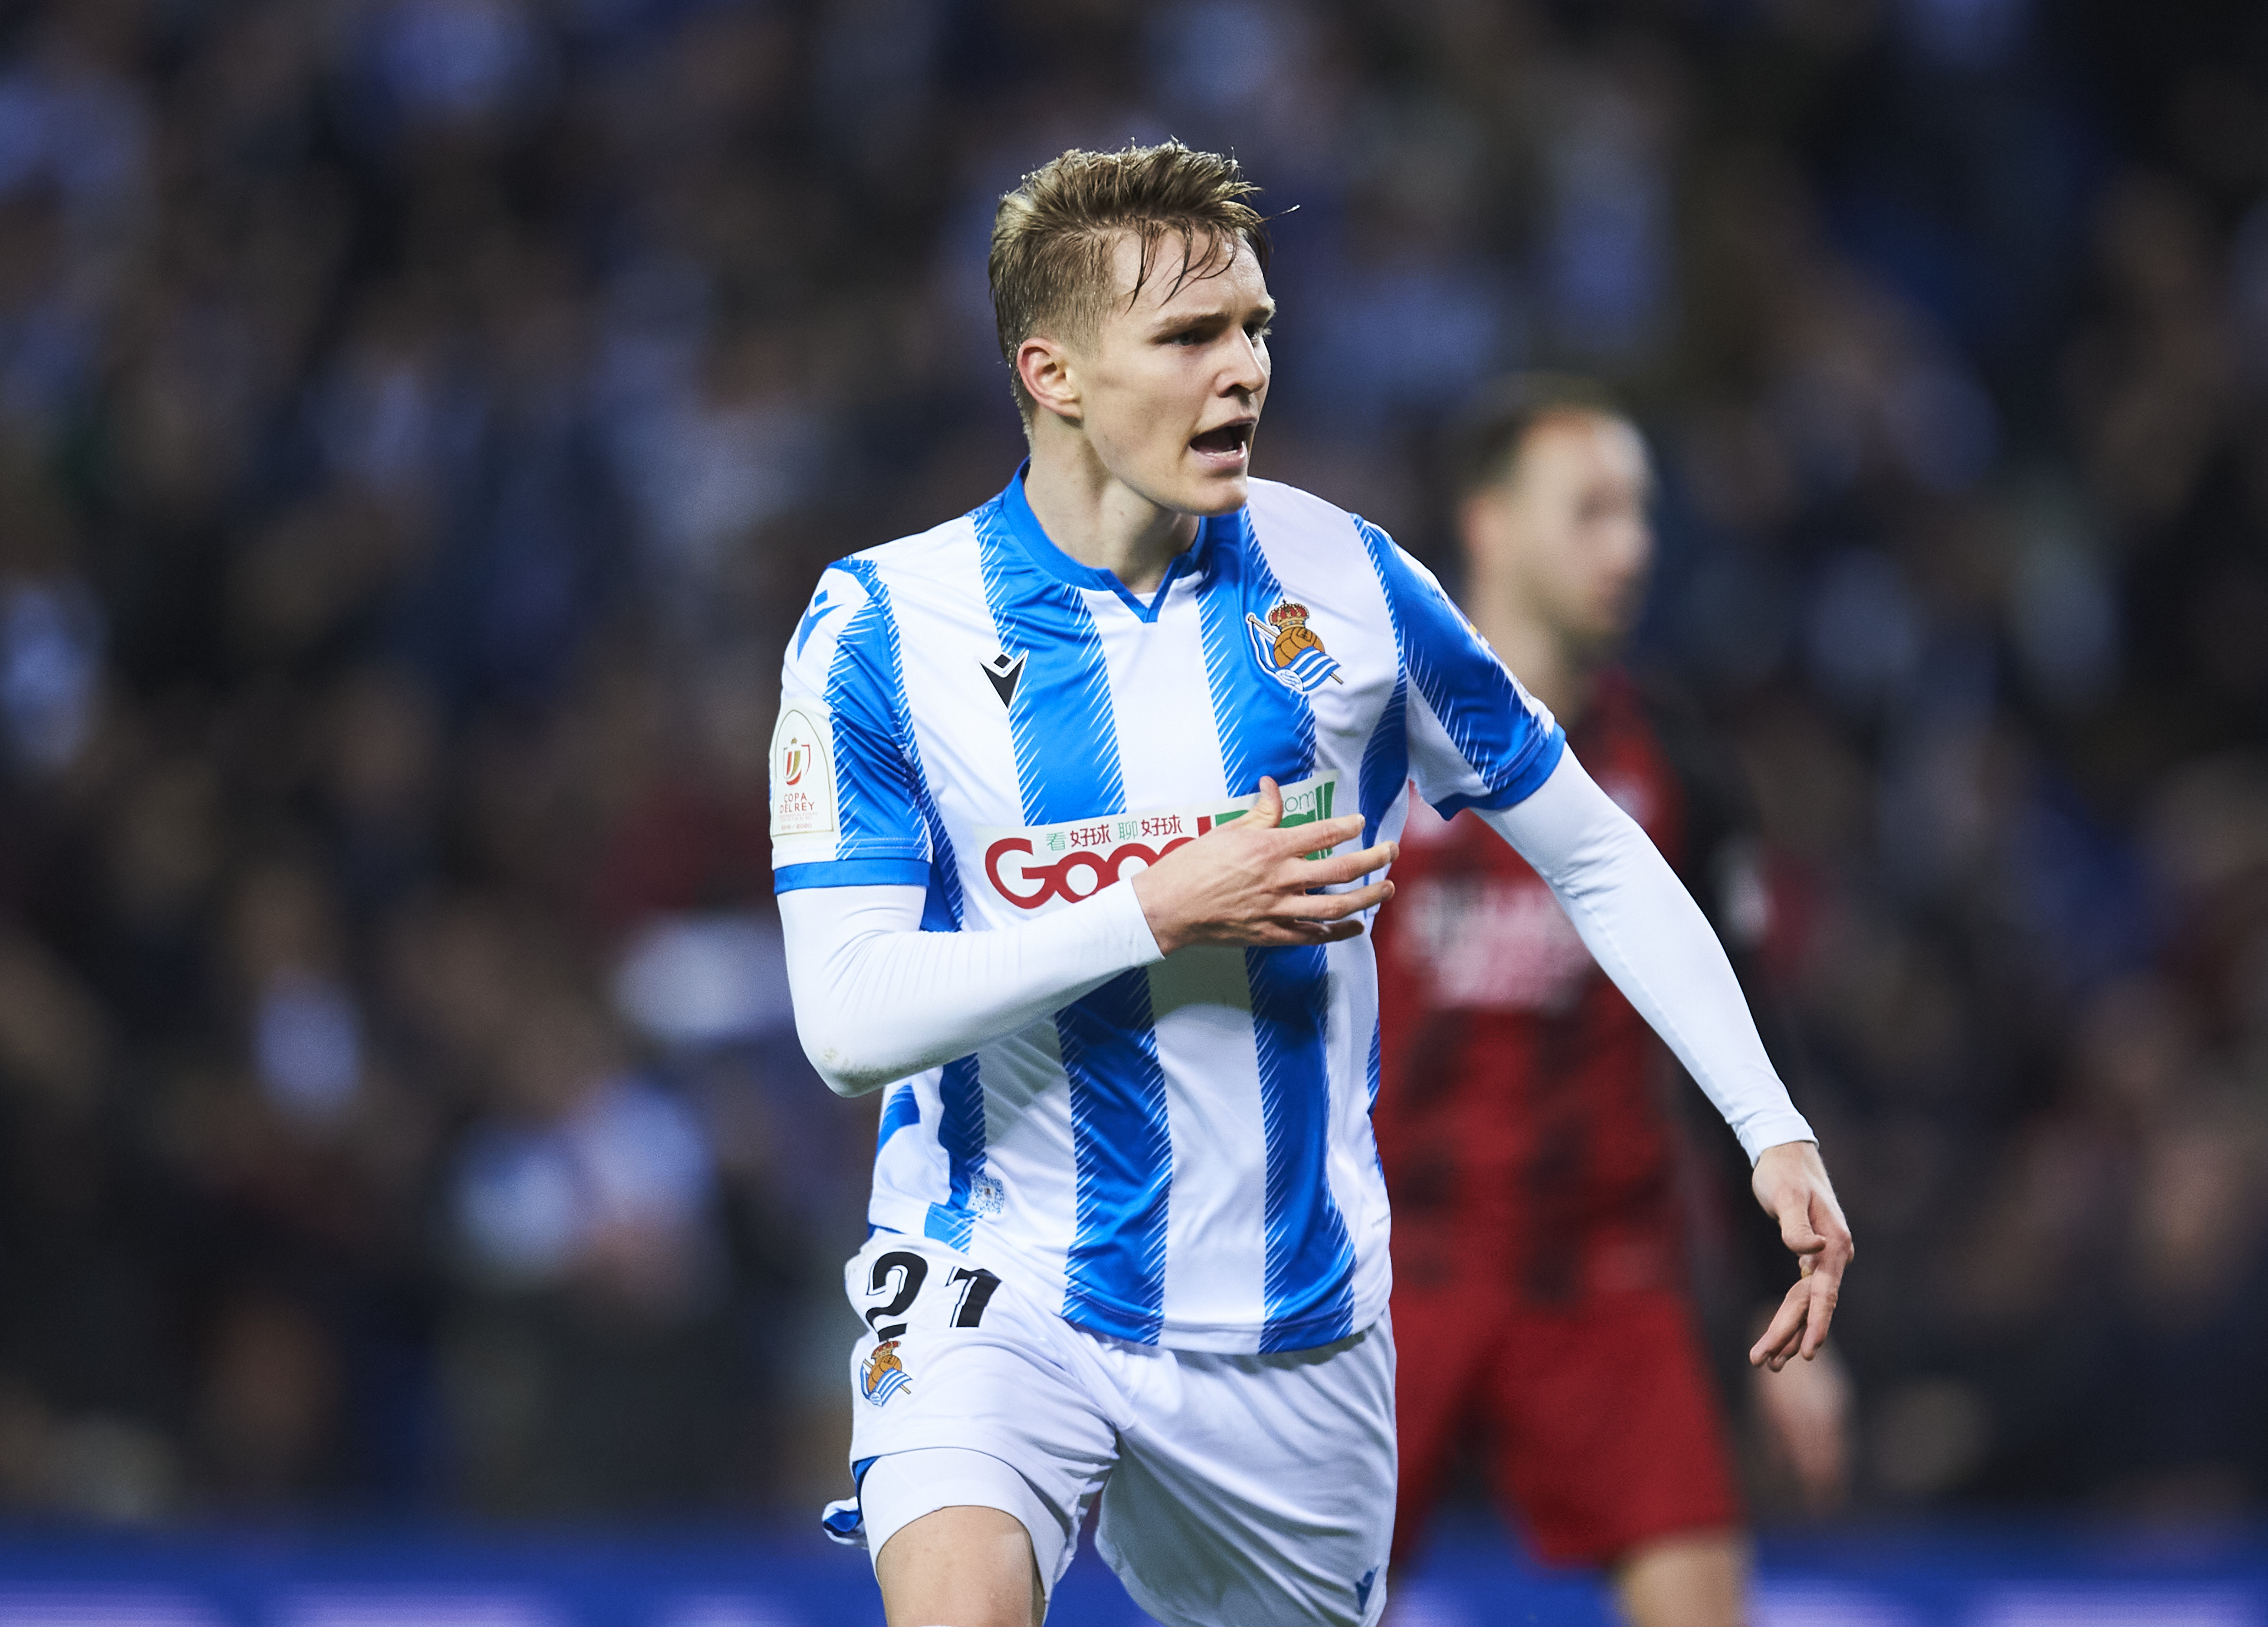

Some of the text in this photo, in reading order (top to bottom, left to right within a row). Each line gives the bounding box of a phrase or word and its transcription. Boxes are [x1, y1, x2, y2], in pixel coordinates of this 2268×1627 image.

[780, 801, 815, 814] DEL REY
[784, 792, 807, 803] COPA
[984, 816, 1212, 909] Goo
[865, 1251, 1003, 1342] 21
